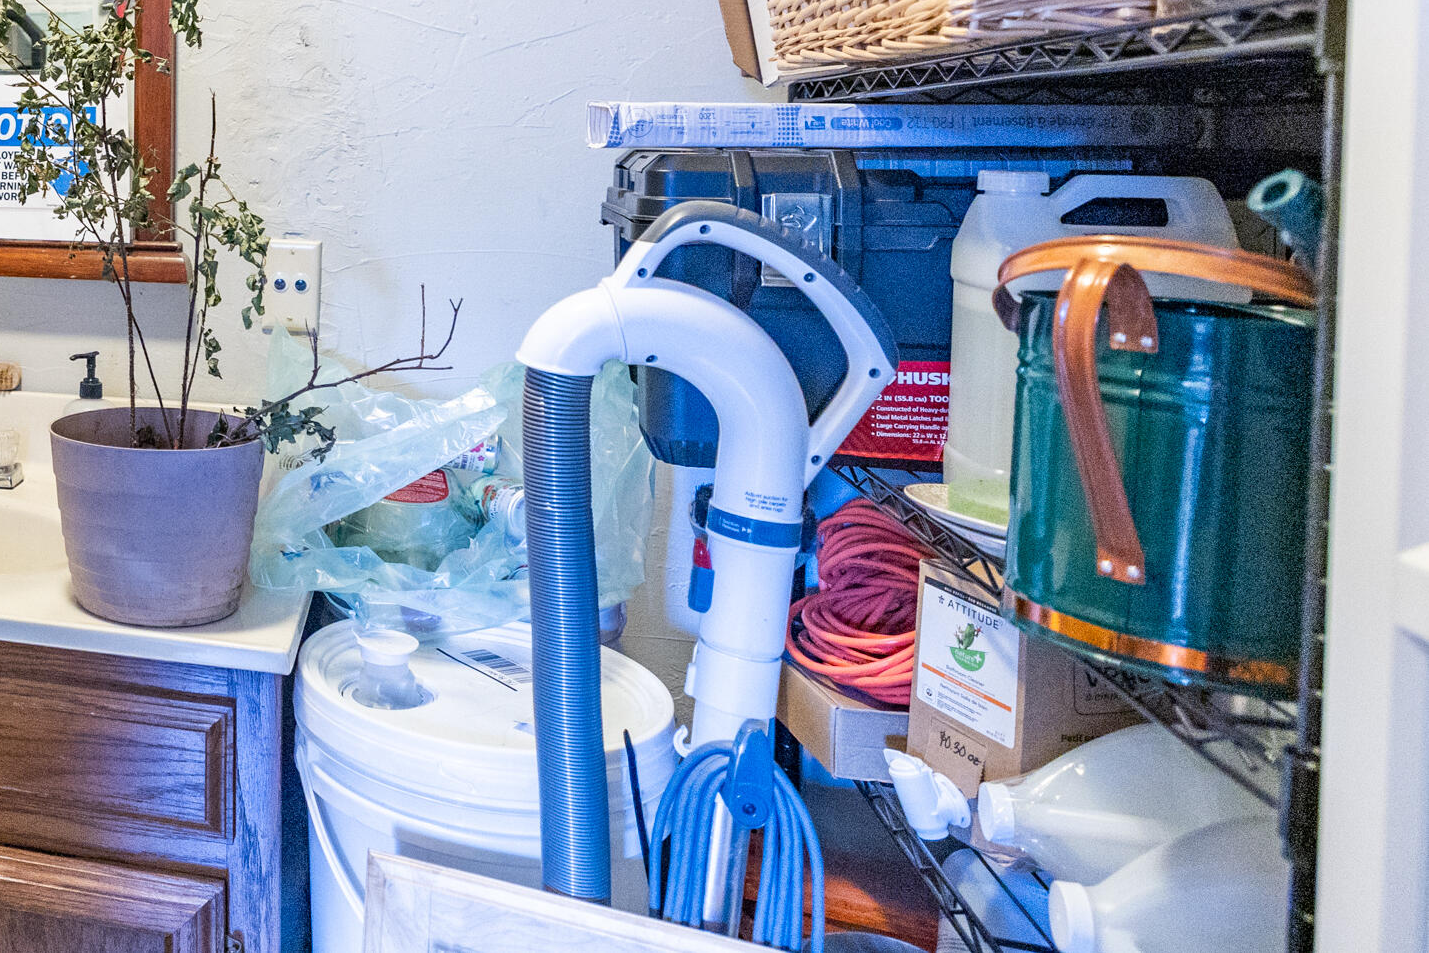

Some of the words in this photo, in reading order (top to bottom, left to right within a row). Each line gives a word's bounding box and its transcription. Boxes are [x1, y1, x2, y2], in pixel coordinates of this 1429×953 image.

[841, 119, 870, 128] White
[871, 119, 892, 128] Cool
[972, 117, 1034, 129] Basement
[1, 171, 29, 180] BEFO
[898, 371, 951, 386] HUSK
[929, 395, 949, 403] TOO
[876, 405, 911, 413] Constructed
[894, 423, 919, 431] Carrying
[948, 599, 1000, 630] ATTITUDE
